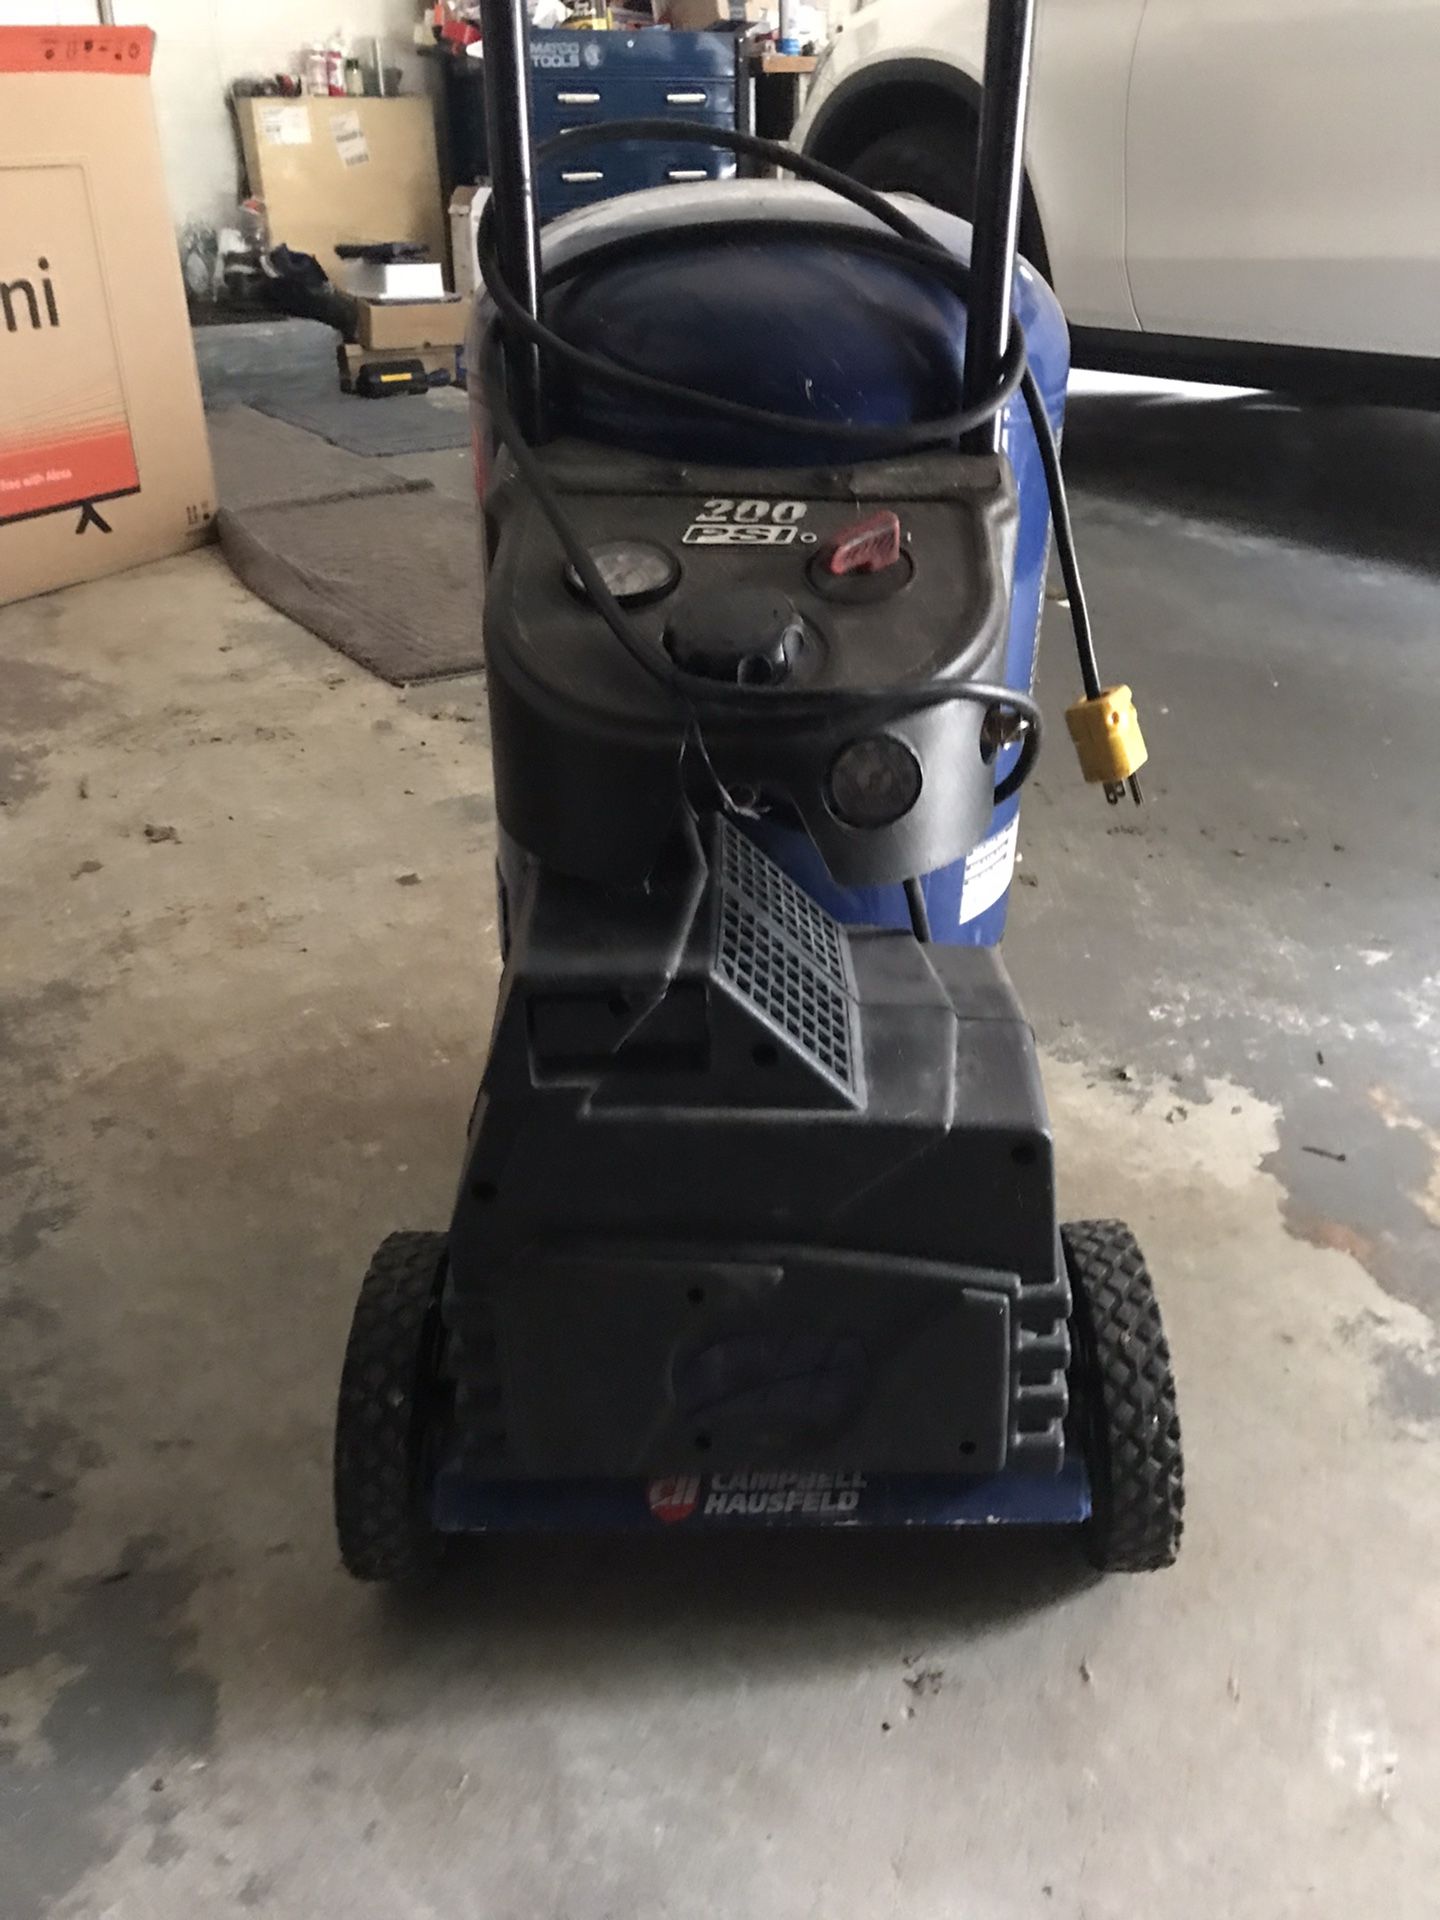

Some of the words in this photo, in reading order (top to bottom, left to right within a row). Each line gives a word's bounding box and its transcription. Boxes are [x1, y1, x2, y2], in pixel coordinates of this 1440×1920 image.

[529, 42, 580, 54] MATCO
[530, 54, 580, 68] TOOLS
[695, 499, 808, 524] 200
[684, 524, 798, 544] PSI
[704, 1489, 862, 1515] HAUSFELD
